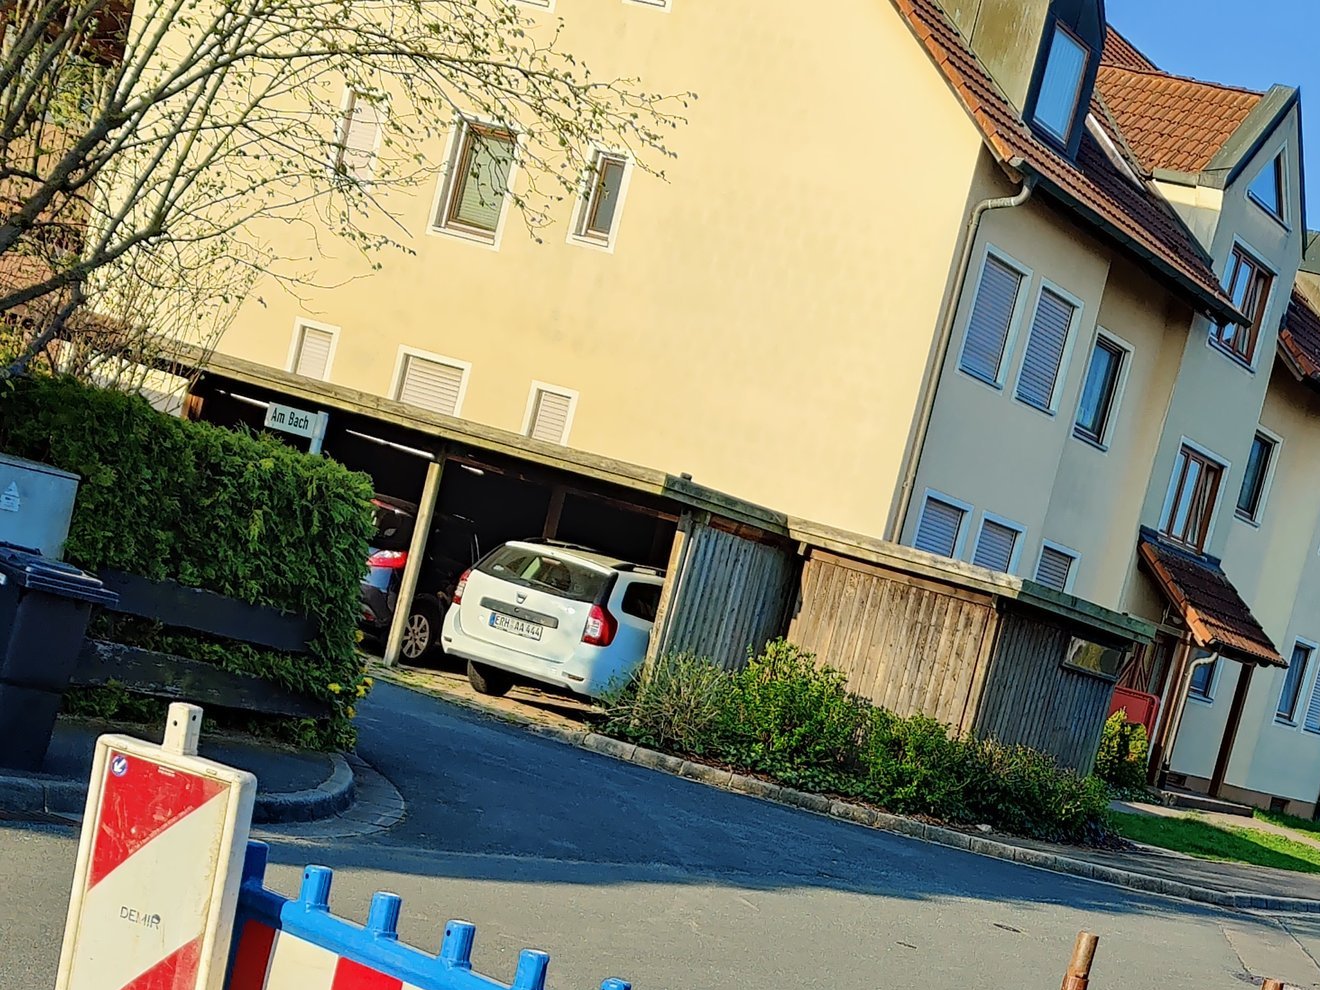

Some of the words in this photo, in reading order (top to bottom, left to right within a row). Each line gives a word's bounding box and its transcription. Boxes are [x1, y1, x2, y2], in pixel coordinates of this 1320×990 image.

[270, 407, 286, 424] Am
[288, 411, 309, 431] Bach
[119, 905, 161, 930] DEMIR
